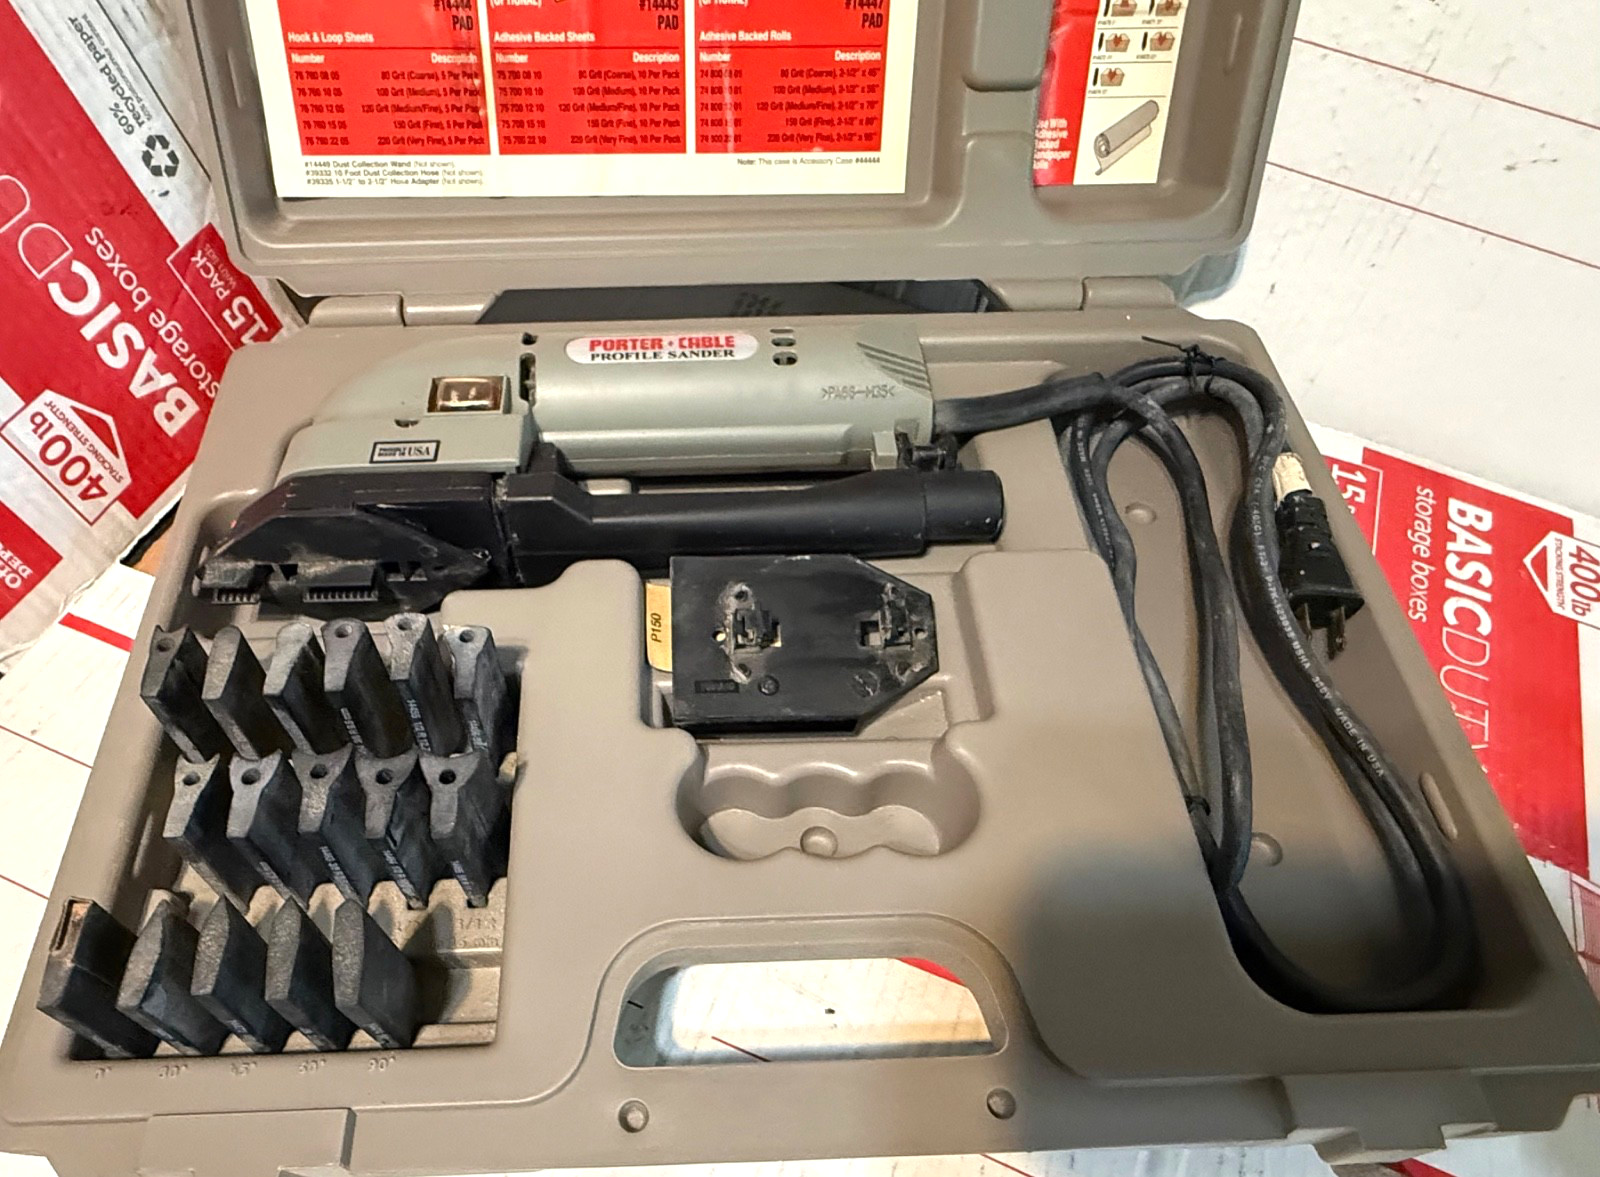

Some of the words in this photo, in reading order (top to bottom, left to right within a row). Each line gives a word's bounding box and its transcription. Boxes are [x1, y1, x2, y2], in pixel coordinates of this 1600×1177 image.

[452, 15, 473, 31] PAD
[657, 14, 679, 30] PAD
[862, 13, 883, 29] PAD
[68, 16, 106, 63] paper
[288, 32, 311, 43] Hook
[312, 32, 320, 43] &
[320, 31, 343, 45] Loop
[344, 31, 374, 43] Sheets
[494, 31, 532, 42] Adhesive
[534, 31, 565, 42] Backed
[567, 31, 595, 42] Sheets
[699, 30, 736, 41] Adhesive
[738, 30, 769, 41] Backed
[770, 29, 792, 41] Rolls
[291, 53, 325, 64] Number
[431, 52, 477, 65] Description
[496, 53, 528, 63] Number
[633, 51, 680, 64] Description
[699, 51, 731, 62] Number
[834, 50, 881, 63] Description
[648, 69, 660, 79] Per
[662, 69, 680, 79] Pack
[100, 63, 145, 129] recycled
[109, 102, 134, 136] 60%
[649, 118, 661, 128] Per
[663, 118, 680, 128] Pack
[650, 134, 662, 144] Per
[663, 134, 681, 144] Pack
[758, 157, 772, 165] This
[792, 157, 798, 165] is
[799, 157, 833, 166] Accessory
[835, 156, 853, 165] Case
[411, 178, 439, 187] Adapter
[84, 226, 152, 314] boxes
[190, 249, 231, 301] PACK
[222, 296, 268, 344] 15
[589, 338, 664, 352] PORTER
[678, 335, 736, 349] CABLE
[149, 309, 220, 399] storage
[590, 351, 662, 361] PROFILE
[667, 348, 736, 359] SANDER
[29, 411, 54, 441] lb
[408, 446, 430, 456] USA
[38, 434, 109, 501] 400
[86, 443, 125, 484] STACKING
[1331, 463, 1367, 504] 15
[1407, 485, 1434, 558] storage
[0, 541, 33, 580] DEP
[1554, 537, 1564, 570] STACKING
[1568, 544, 1600, 603] 400
[1408, 559, 1436, 624] boxes
[1571, 598, 1591, 617] lb
[650, 612, 662, 643] P150
[1440, 497, 1493, 750] BASICDUT
[1334, 706, 1357, 738] MADE
[1357, 738, 1369, 752] IN
[1367, 753, 1385, 778] USA
